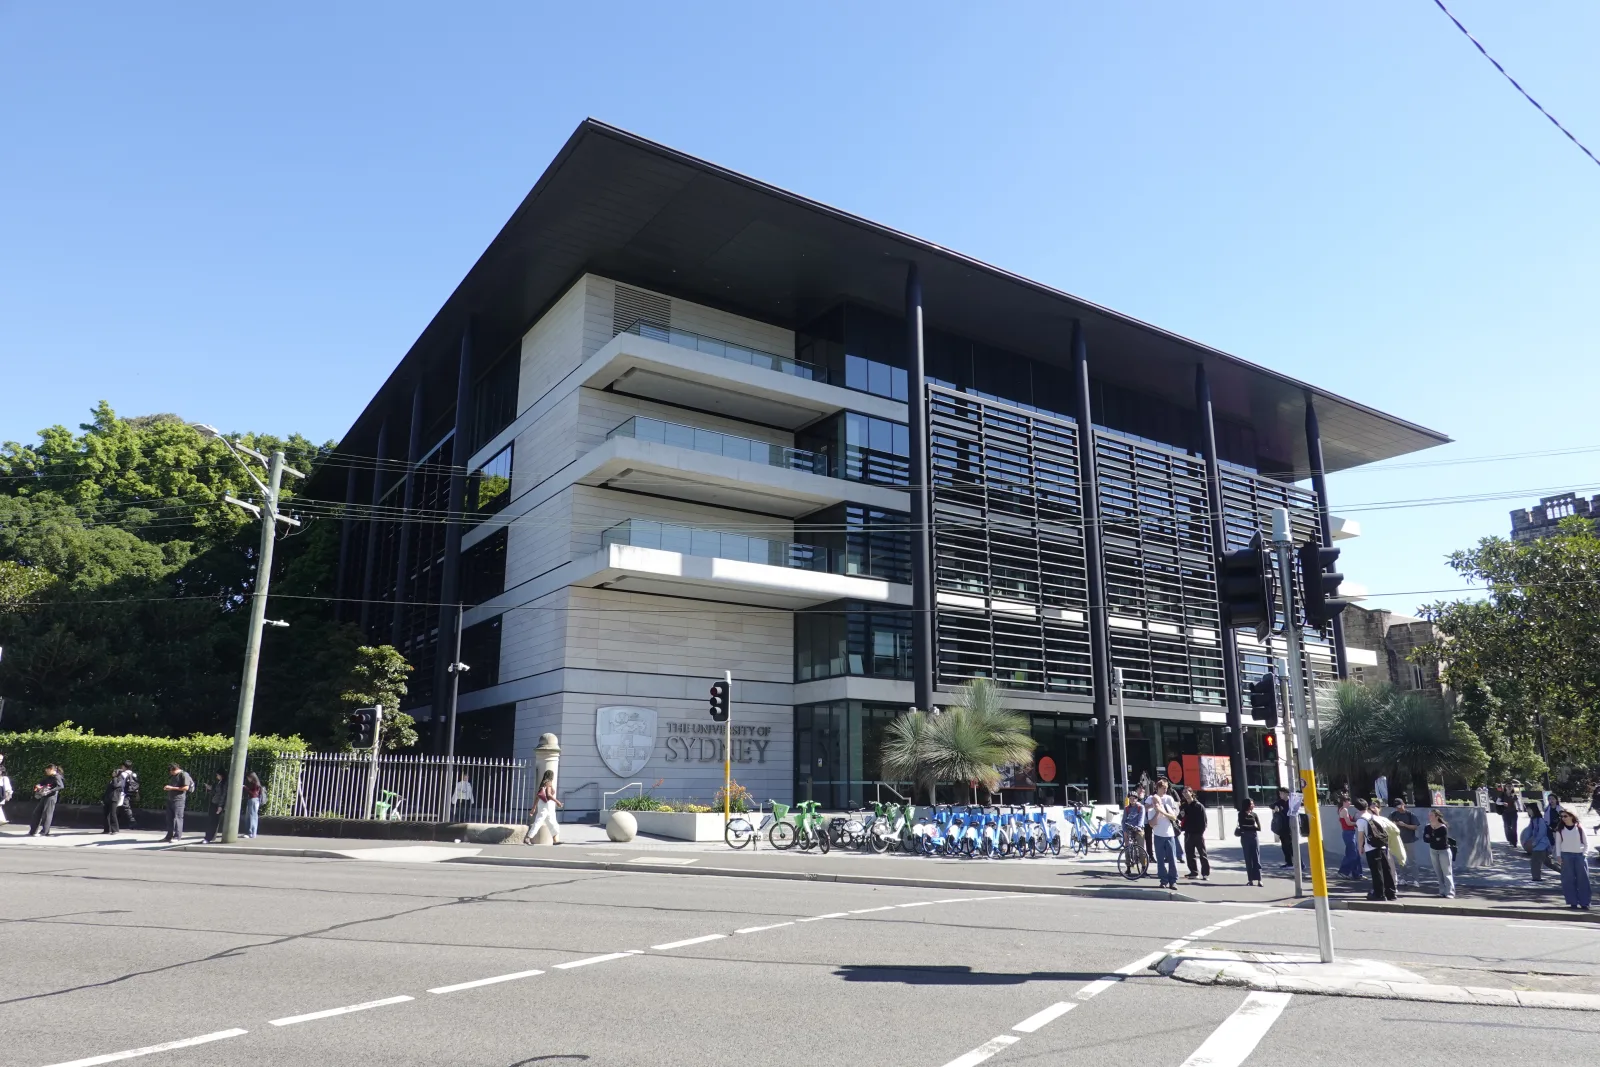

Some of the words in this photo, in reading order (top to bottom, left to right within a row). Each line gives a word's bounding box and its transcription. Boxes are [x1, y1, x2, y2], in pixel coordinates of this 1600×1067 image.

[667, 723, 690, 734] THE
[692, 724, 755, 736] UNIVESITY
[756, 726, 771, 737] OF
[665, 736, 770, 763] SYDNEY
